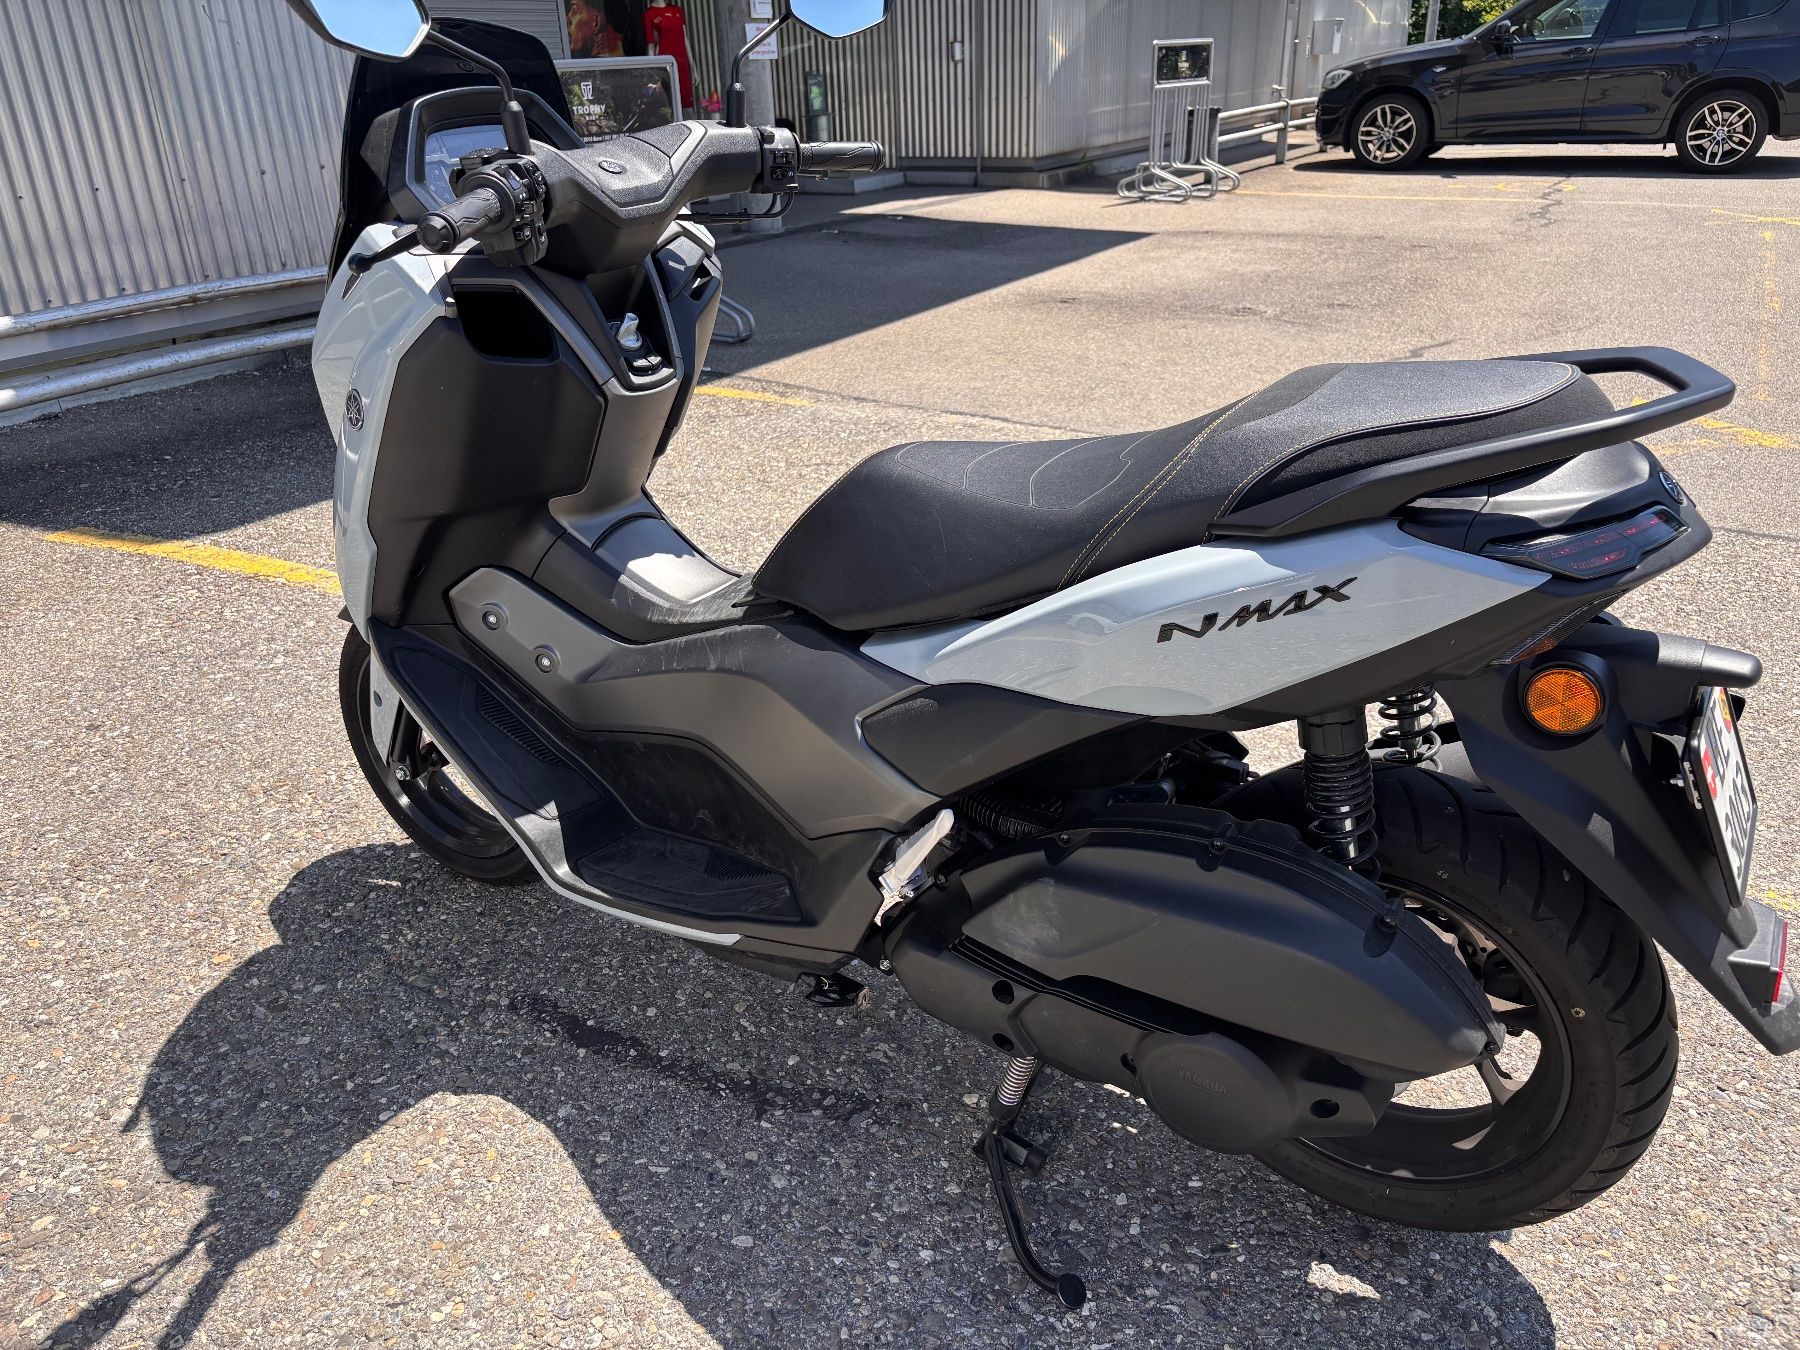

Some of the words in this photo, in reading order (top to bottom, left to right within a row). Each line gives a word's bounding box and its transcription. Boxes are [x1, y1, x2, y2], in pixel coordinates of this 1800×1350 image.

[572, 104, 606, 115] TROPHY
[1156, 576, 1358, 644] NMAX
[1176, 1064, 1228, 1096] YAMAHA
